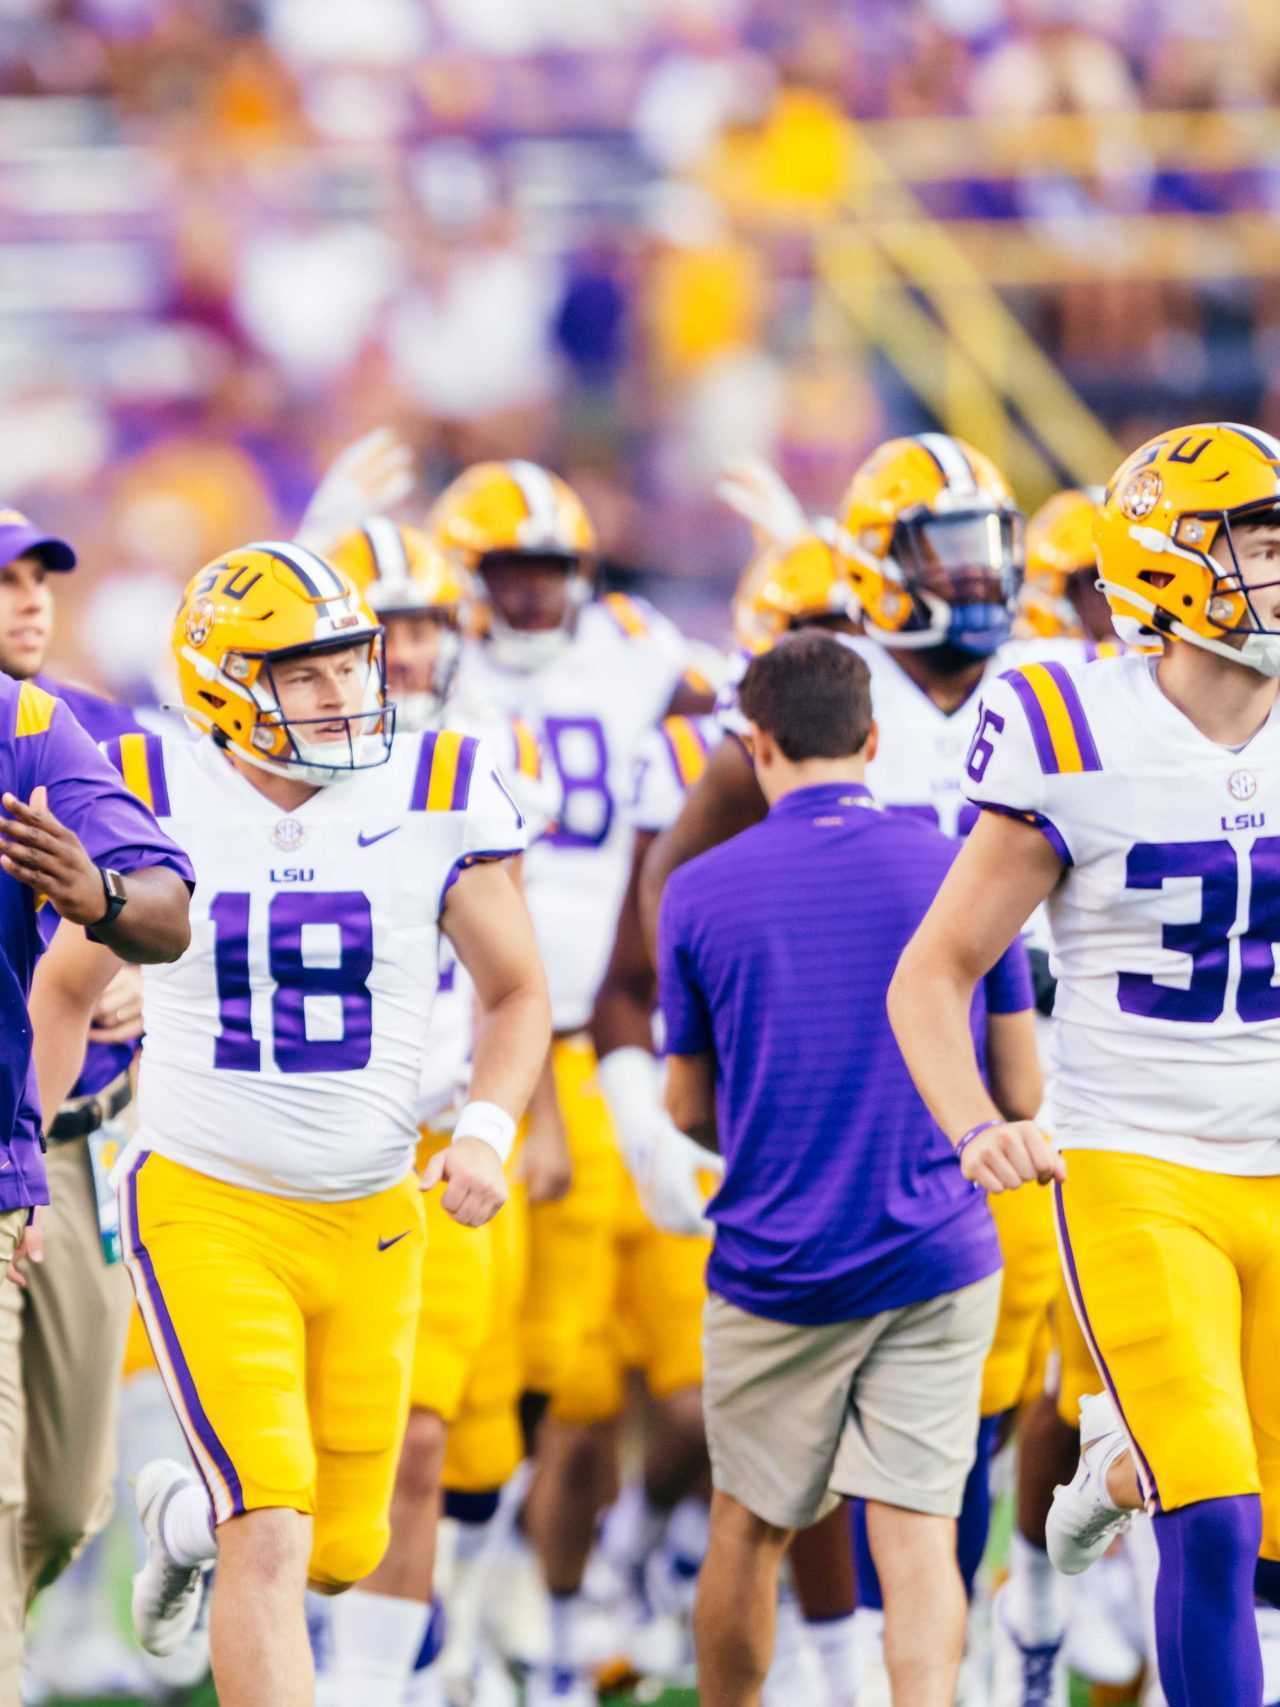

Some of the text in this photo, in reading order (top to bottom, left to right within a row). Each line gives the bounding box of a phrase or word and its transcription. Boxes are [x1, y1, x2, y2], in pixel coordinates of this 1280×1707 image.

[1220, 812, 1265, 831] LSU
[269, 867, 315, 883] LSU
[208, 891, 374, 1074] 18
